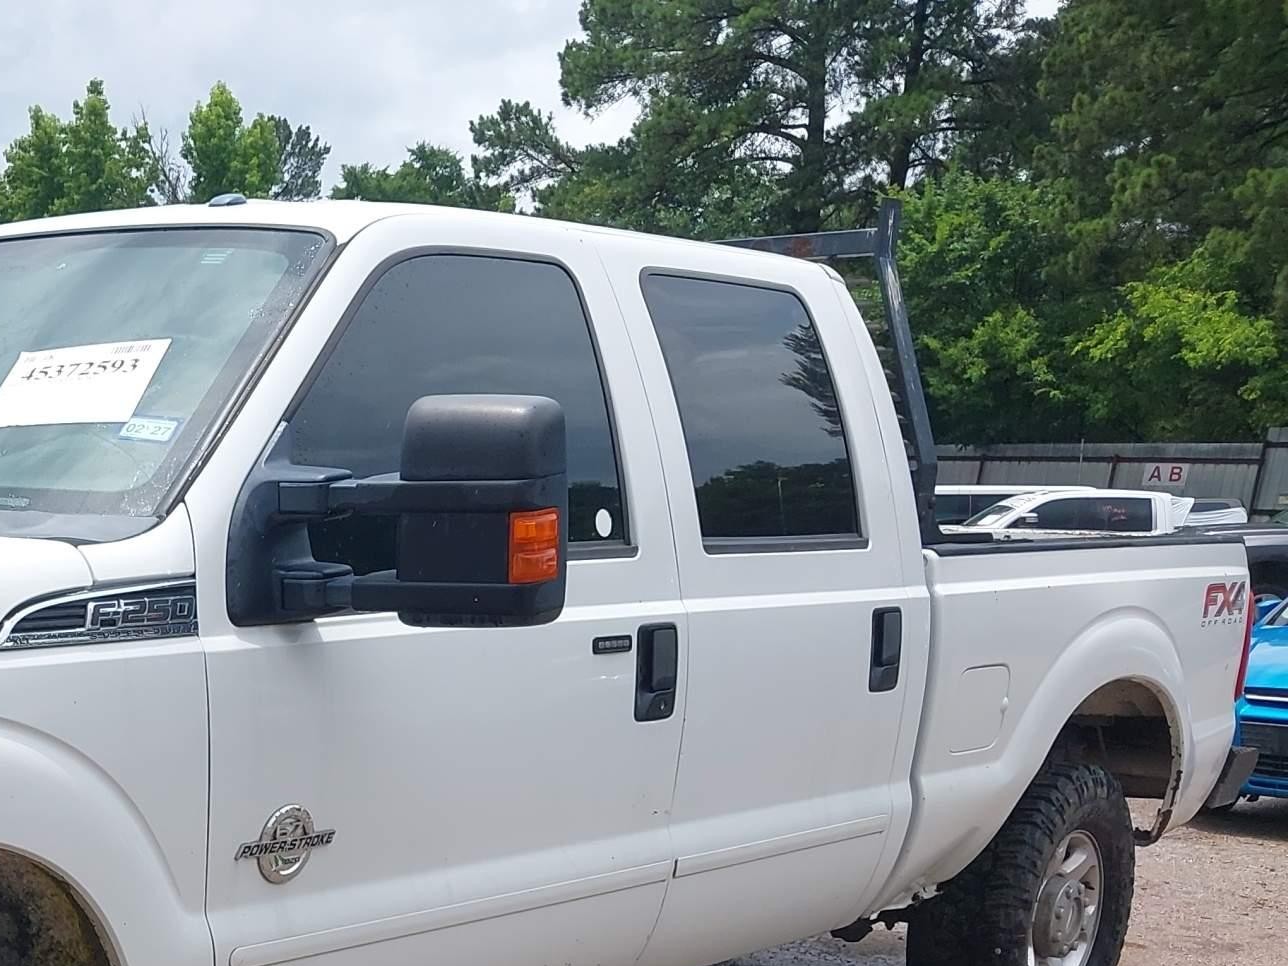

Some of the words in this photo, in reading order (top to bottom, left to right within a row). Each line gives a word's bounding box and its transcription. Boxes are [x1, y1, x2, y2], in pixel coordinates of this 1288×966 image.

[21, 357, 140, 381] 45372593
[1148, 465, 1162, 482] A
[1169, 466, 1183, 482] B
[1202, 581, 1246, 619] FX4
